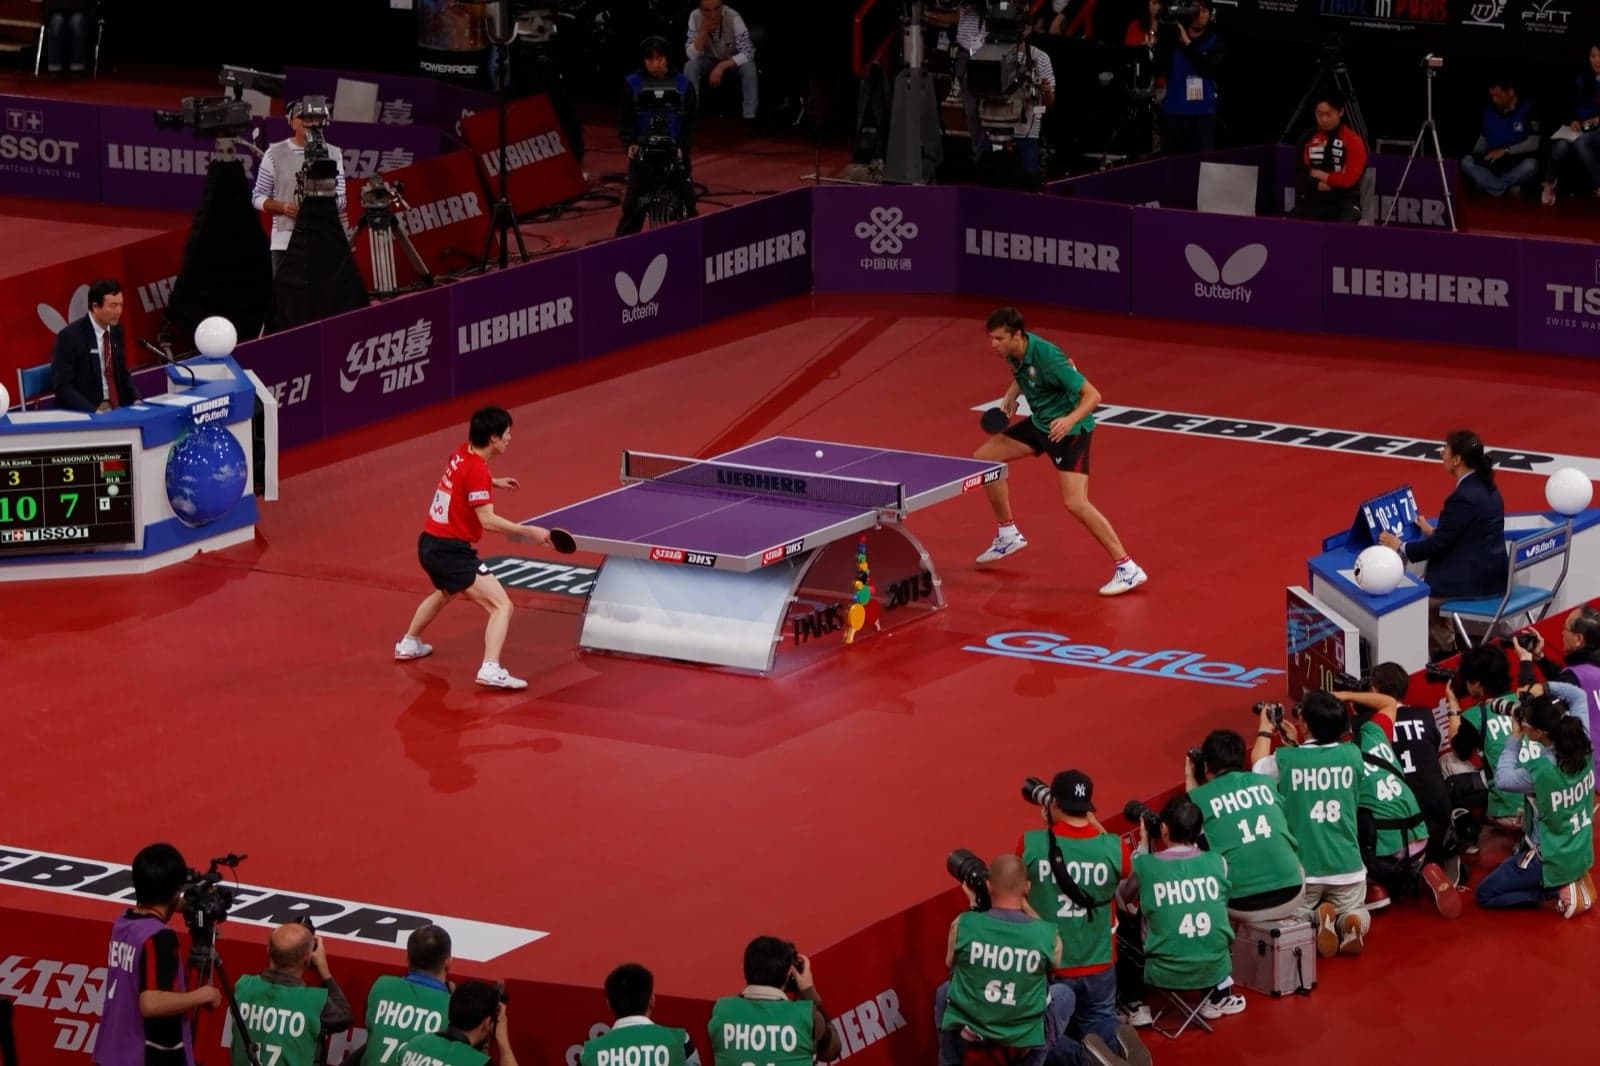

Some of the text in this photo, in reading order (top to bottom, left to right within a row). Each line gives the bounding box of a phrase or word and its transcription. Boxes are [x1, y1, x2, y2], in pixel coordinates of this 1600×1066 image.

[420, 61, 479, 75] POWERADE
[0, 134, 80, 166] SSOT
[108, 143, 254, 180] LIEBHER
[343, 146, 414, 179] 双喜
[481, 130, 567, 177] LIEBHERR
[395, 192, 483, 237] EBHERR
[705, 229, 806, 284] LIEBHERR
[860, 257, 912, 271] 中国联通
[966, 228, 1120, 273] LIEBHERR
[1194, 282, 1252, 304] Butterfly
[1332, 266, 1510, 308] LIEBHERR
[1546, 283, 1600, 316] TIS
[457, 296, 574, 355] LIEBHERR
[621, 301, 659, 325] Butterfly
[346, 318, 433, 374] 红双喜
[287, 374, 312, 407] 21
[380, 359, 430, 394] DHS
[1093, 406, 1554, 471] IEBHERR
[8, 466, 75, 487] 3 3
[716, 468, 808, 495] LIEBHERR
[0, 492, 80, 523] 10 7
[1399, 497, 1412, 522] 7
[27, 527, 88, 540] TISSOT
[686, 553, 715, 566] DHS
[886, 571, 932, 610] 2013
[985, 630, 1287, 682] Gerflor
[1393, 719, 1425, 742] TTF
[1291, 766, 1353, 792] PHOTO
[1376, 773, 1402, 801] 46
[1551, 770, 1595, 812] PHOTO
[1210, 784, 1275, 818] PHOTO
[1310, 800, 1341, 824] 48
[1236, 814, 1271, 844] 14
[1569, 809, 1592, 836] 11
[1038, 859, 1109, 887] POTO
[1153, 876, 1219, 907] PHOTO
[1178, 912, 1211, 938] 49
[969, 941, 1041, 974] PHOTO
[983, 980, 1017, 1006] 61
[240, 1002, 305, 1038] PHOTO
[375, 999, 442, 1034] PHOTO
[377, 1036, 409, 1064] 7
[723, 1022, 798, 1052] PHOTO
[596, 1044, 670, 1066] PHOTO
